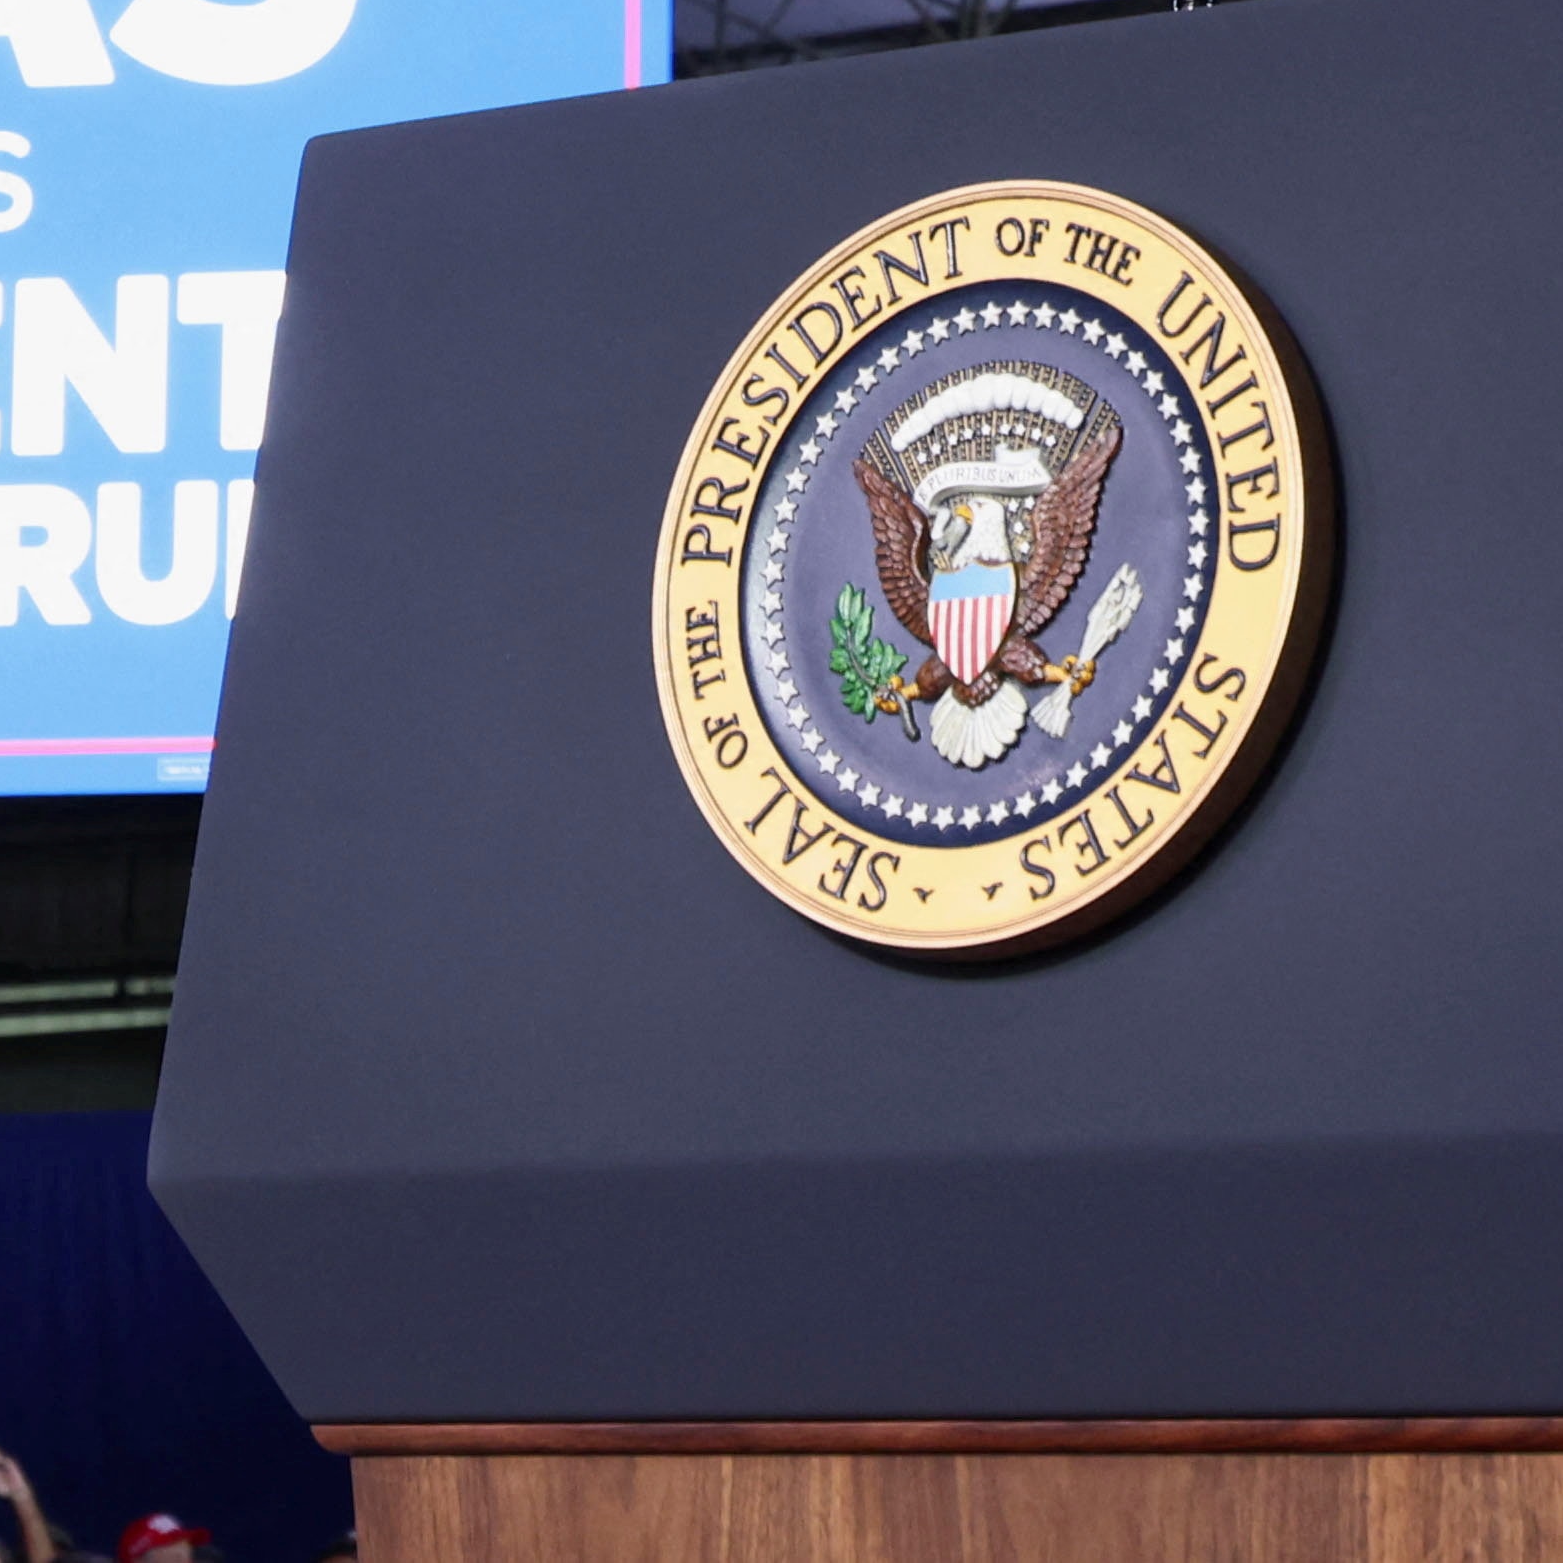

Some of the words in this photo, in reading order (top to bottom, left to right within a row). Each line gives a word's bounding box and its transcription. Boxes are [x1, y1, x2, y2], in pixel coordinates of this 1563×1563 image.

[996, 218, 1050, 257] OF
[1065, 222, 1141, 286] THE
[681, 216, 970, 566] PRESIDENT
[1156, 271, 1281, 572] UNITED
[685, 600, 722, 700] THE
[702, 714, 750, 769] OF
[1020, 653, 1247, 900] STATES
[742, 767, 901, 912] SEAL
